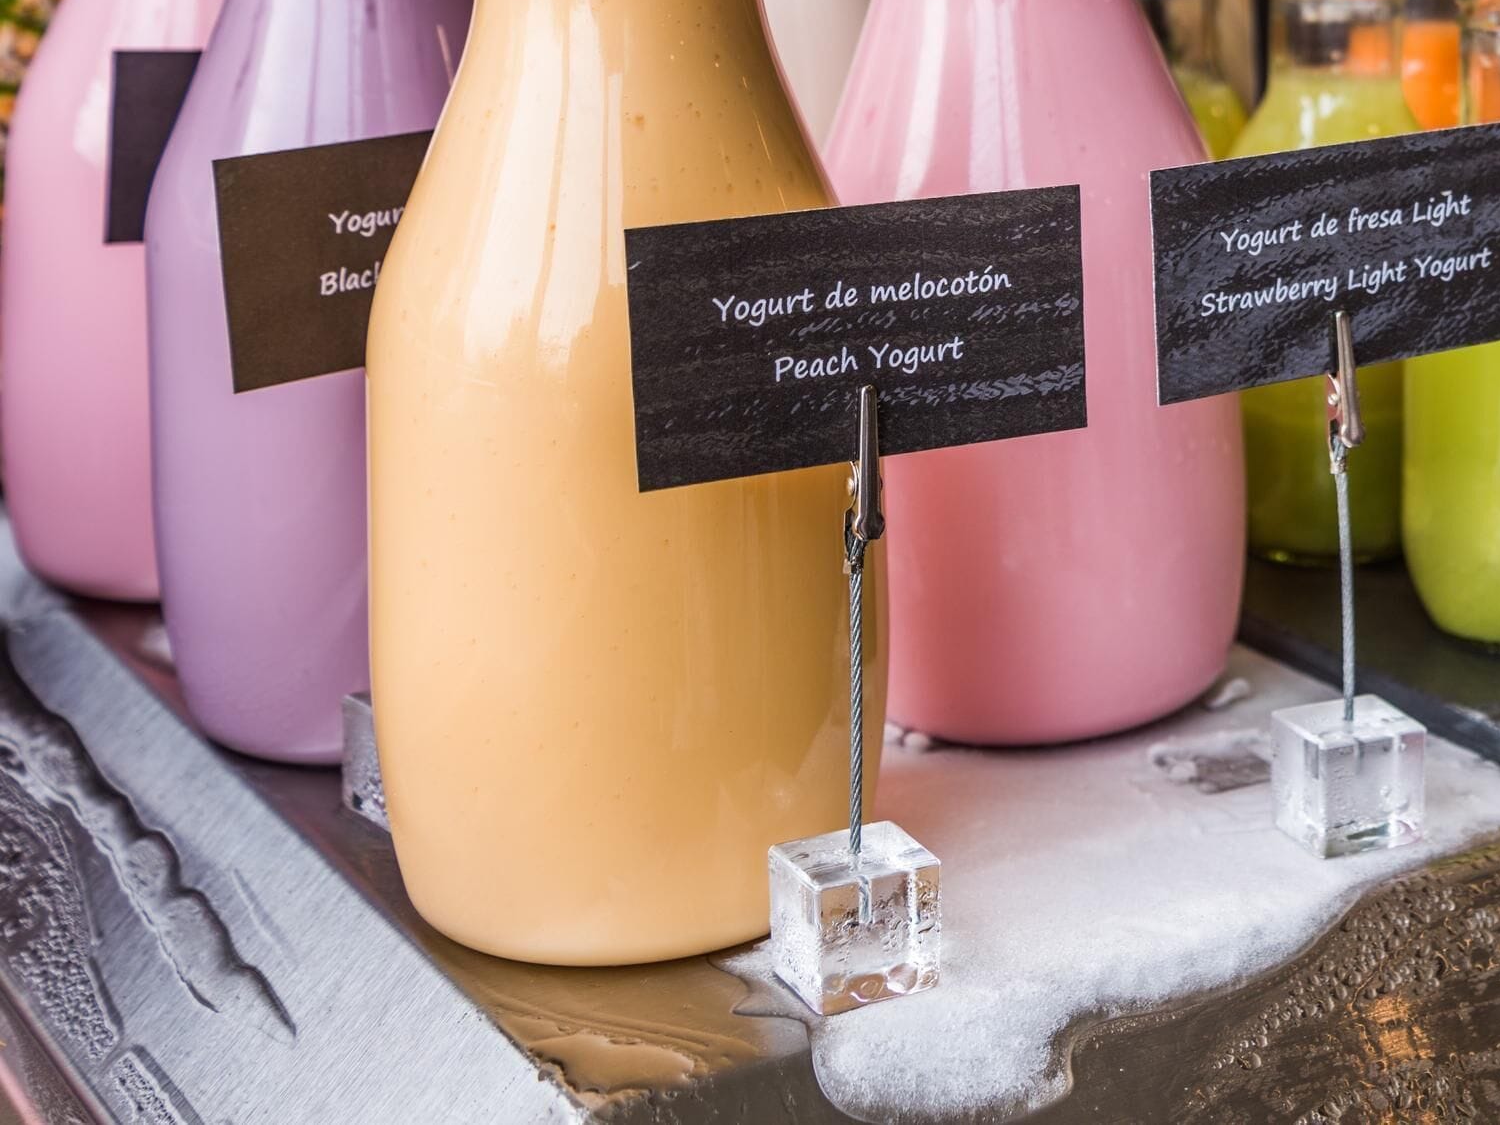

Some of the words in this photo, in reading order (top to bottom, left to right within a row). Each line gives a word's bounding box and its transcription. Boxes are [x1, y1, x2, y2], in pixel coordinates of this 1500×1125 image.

[1220, 221, 1302, 255] Yogurt
[1310, 213, 1338, 239] de
[1347, 207, 1403, 233] fresa
[1412, 194, 1472, 226] Light
[712, 288, 815, 326] Yogurt
[825, 281, 858, 309] de
[871, 265, 1012, 304] melocotón
[1200, 277, 1338, 317] Strawberry
[1347, 261, 1407, 295] Light
[1414, 247, 1493, 282] Yogurt
[774, 346, 858, 382] Peach
[868, 336, 964, 374] Yogurt
